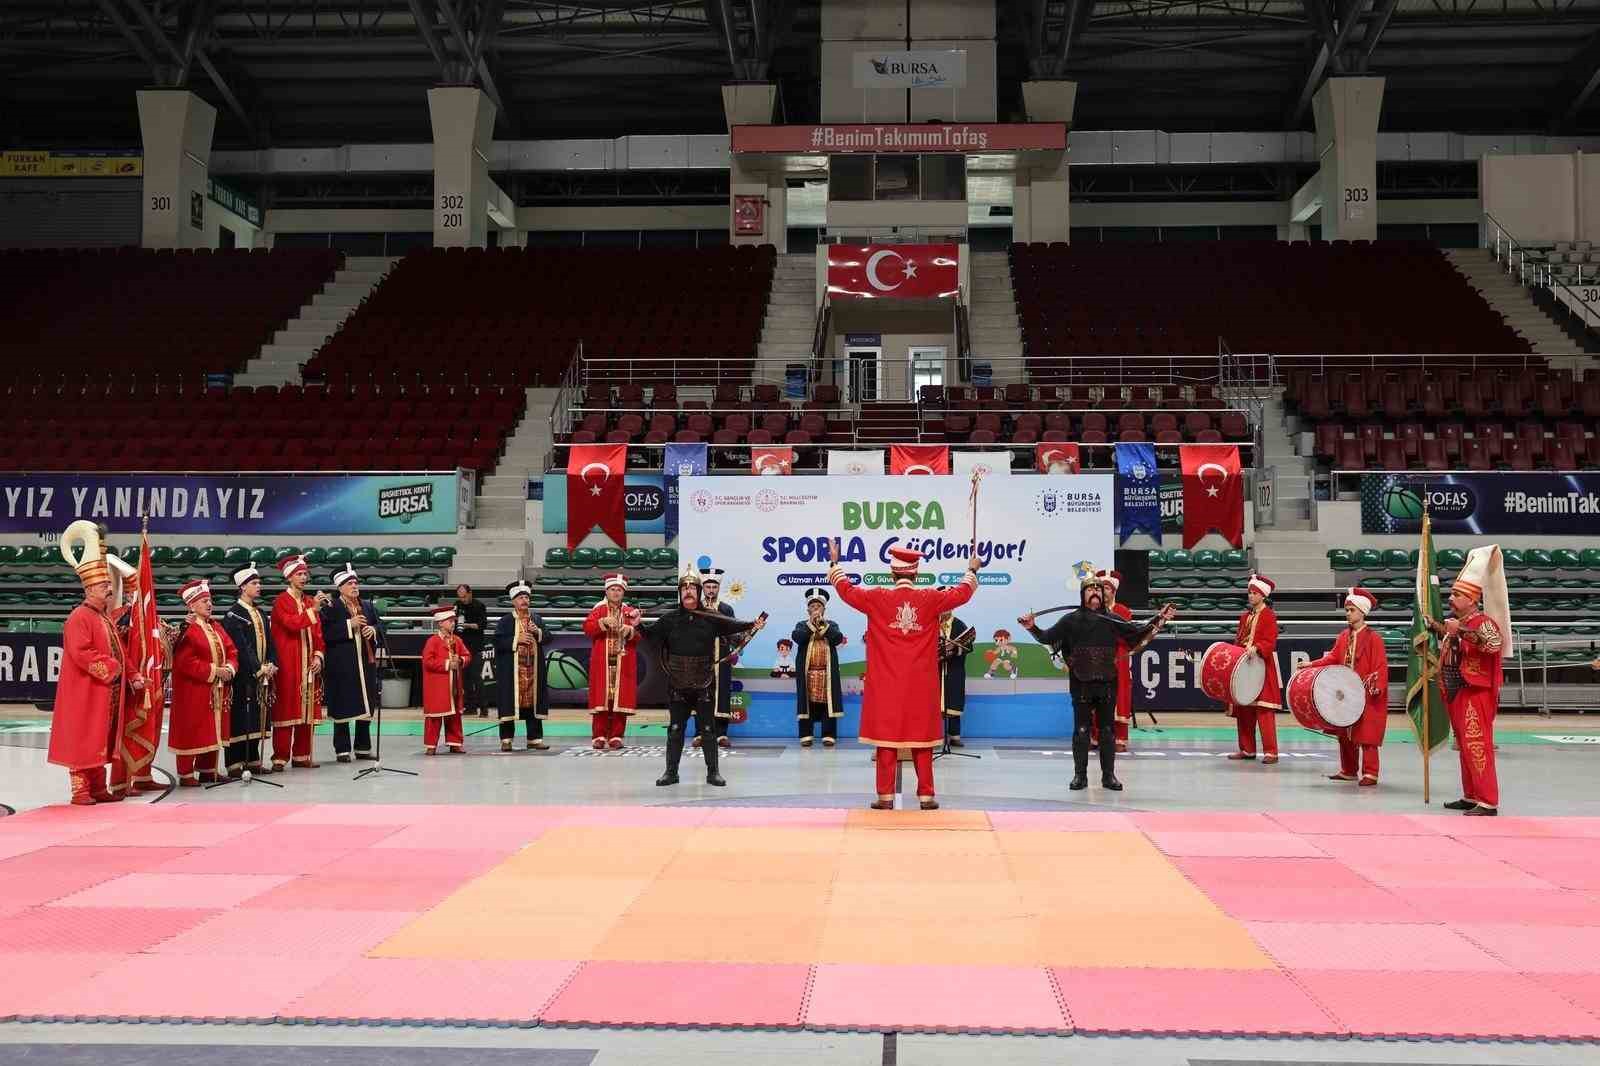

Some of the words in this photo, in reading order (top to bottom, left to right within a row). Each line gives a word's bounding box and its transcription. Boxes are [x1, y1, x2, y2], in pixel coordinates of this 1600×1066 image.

[891, 63, 938, 75] BURSA
[441, 195, 464, 209] 302
[1345, 188, 1369, 202] 303
[151, 197, 170, 210] 301
[443, 214, 462, 227] 201
[1583, 288, 1600, 302] 30
[1067, 493, 1101, 501] BURSA
[1124, 487, 1157, 495] BURSA
[1259, 485, 1271, 506] 102
[72, 488, 266, 519] YANINDAYIZ
[380, 494, 429, 516] BURSA
[624, 493, 659, 509] OFAŞ
[1425, 492, 1468, 509] TOFAŞ
[842, 501, 945, 531] BURSA
